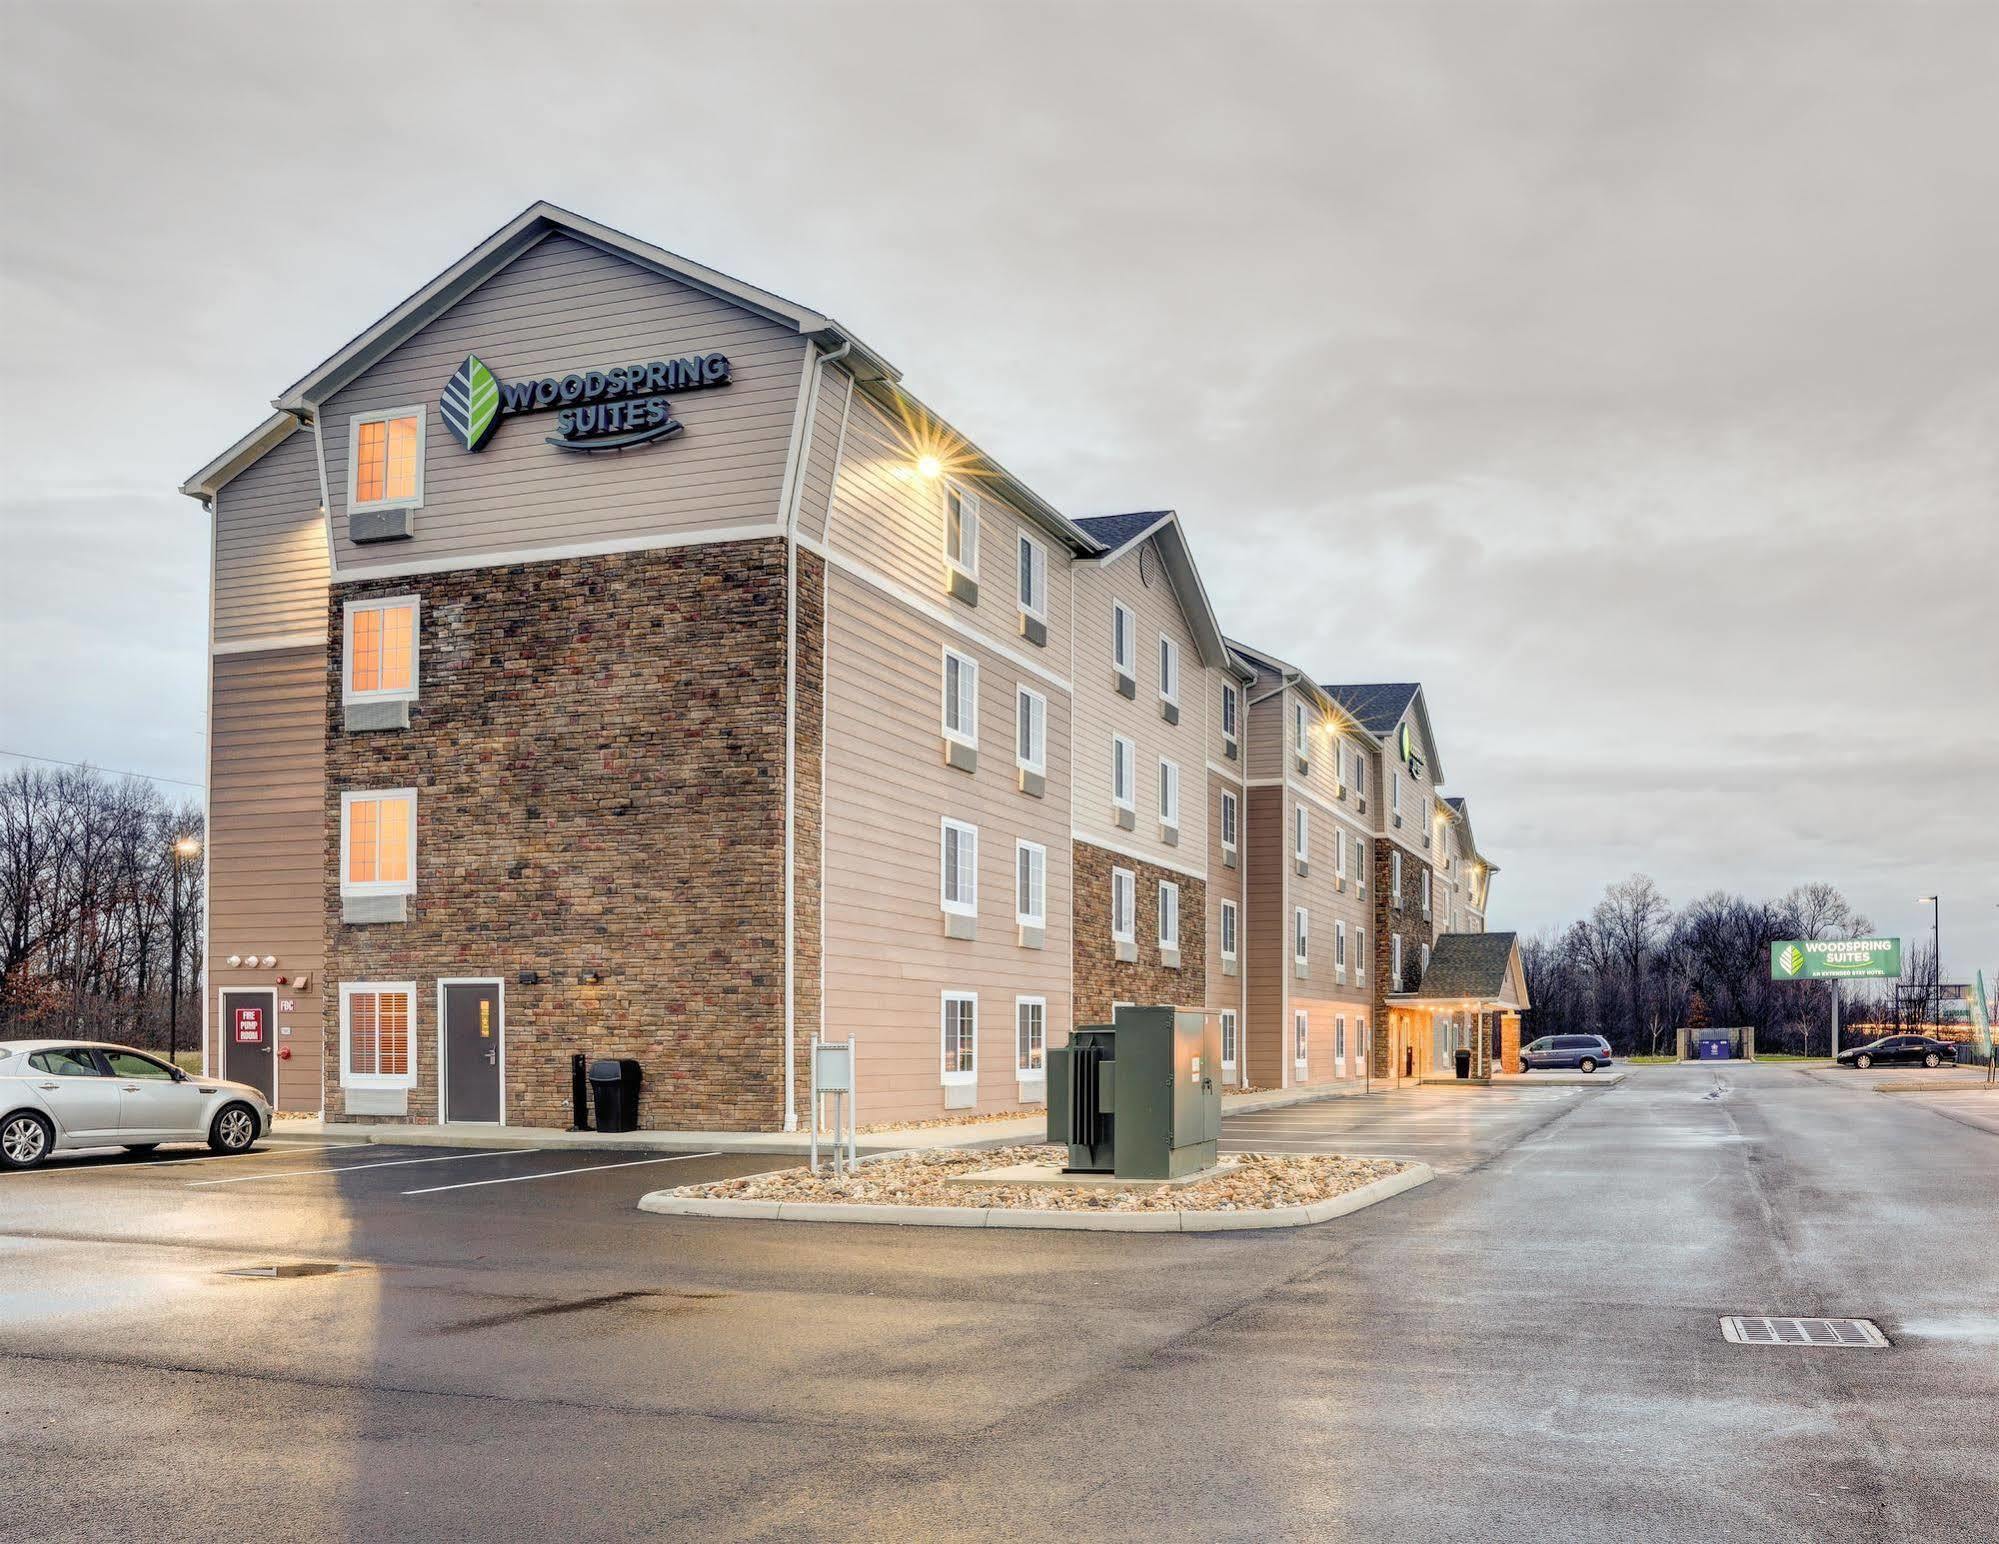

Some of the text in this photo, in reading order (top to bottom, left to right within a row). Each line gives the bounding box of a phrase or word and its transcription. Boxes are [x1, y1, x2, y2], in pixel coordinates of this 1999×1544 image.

[503, 352, 731, 412] WOODSPRING
[557, 397, 669, 438] SUITES
[1805, 940, 1892, 953] WOODSPRING
[1826, 952, 1871, 963] SUITES
[280, 1000, 294, 1011] FDC
[242, 1011, 255, 1020] FIRE
[240, 1021, 258, 1030] PUMP
[240, 1031, 258, 1040] ROOM
